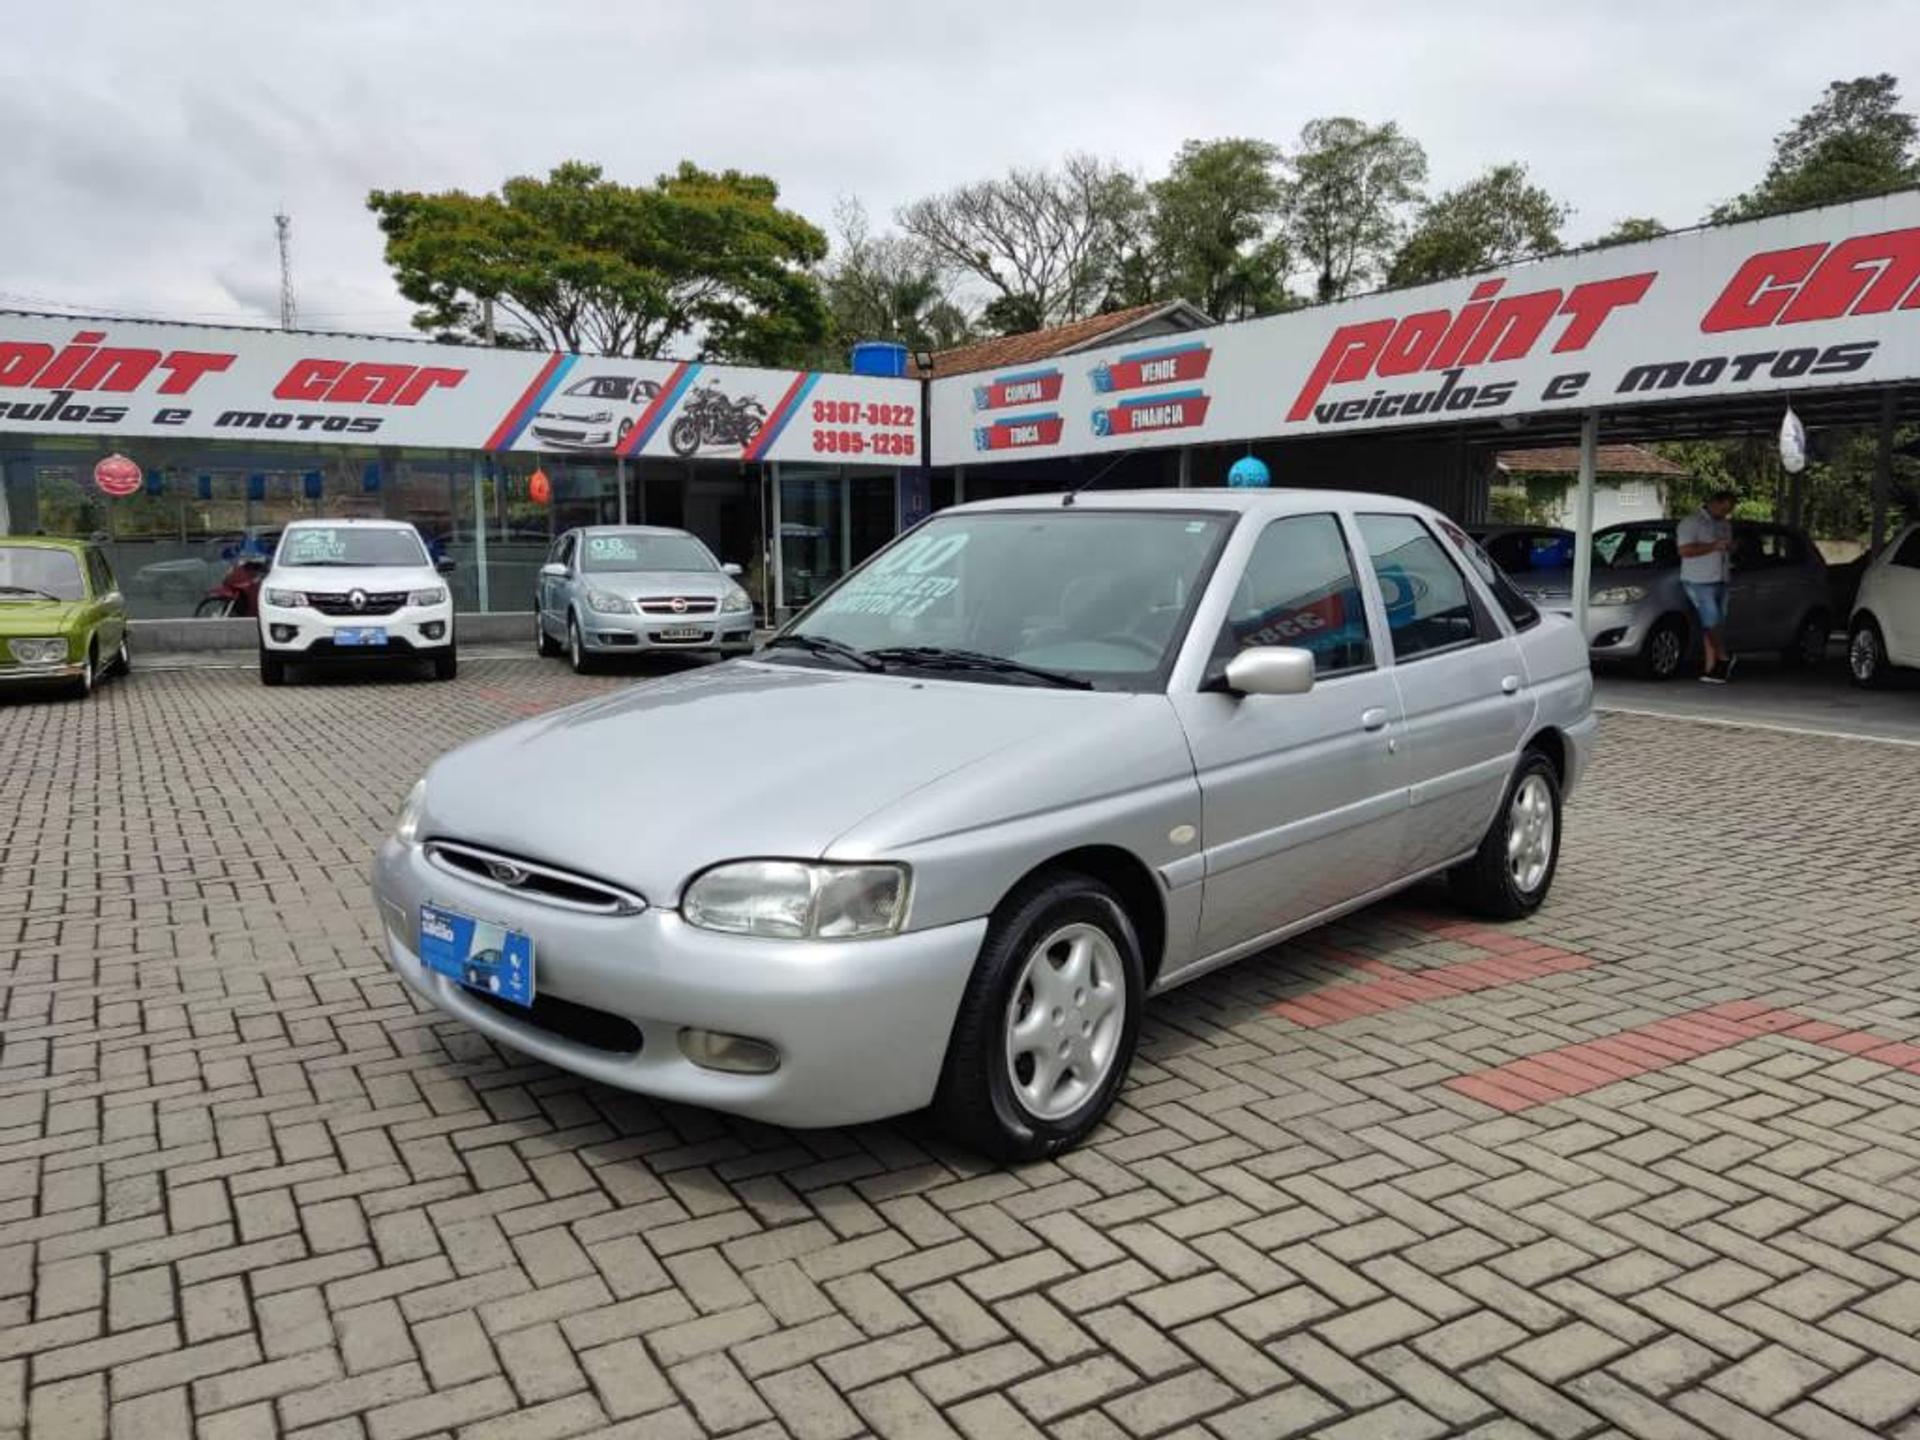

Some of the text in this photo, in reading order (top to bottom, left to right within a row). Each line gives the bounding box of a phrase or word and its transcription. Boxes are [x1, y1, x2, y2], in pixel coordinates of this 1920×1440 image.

[1139, 358, 1178, 383] VENDE
[1004, 380, 1043, 403] COMPRA
[1541, 371, 1591, 401] e
[152, 408, 192, 425] e
[1131, 404, 1184, 429] FINANCIA
[1010, 425, 1041, 445] TROCA
